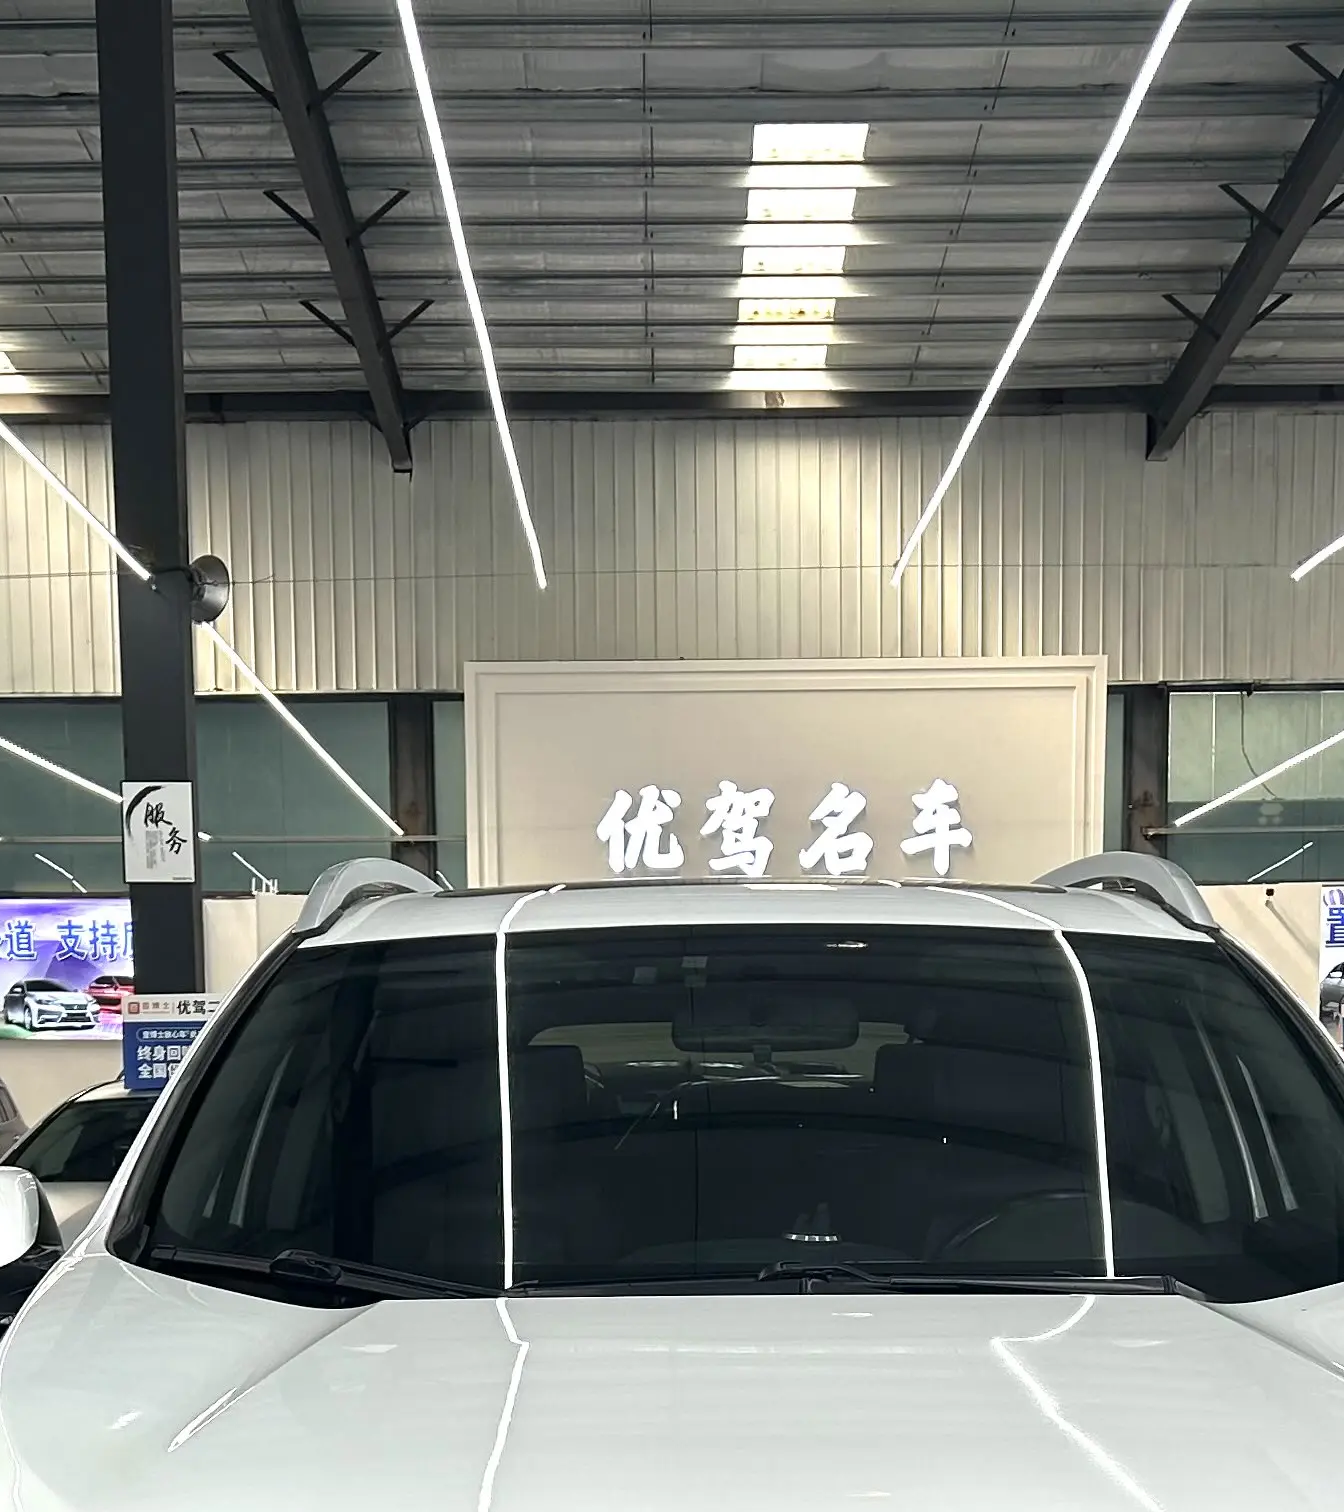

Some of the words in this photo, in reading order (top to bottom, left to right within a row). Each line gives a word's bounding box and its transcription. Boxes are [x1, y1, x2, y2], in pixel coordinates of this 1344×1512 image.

[144, 802, 187, 854] 服务
[596, 778, 973, 876] 优驾名车
